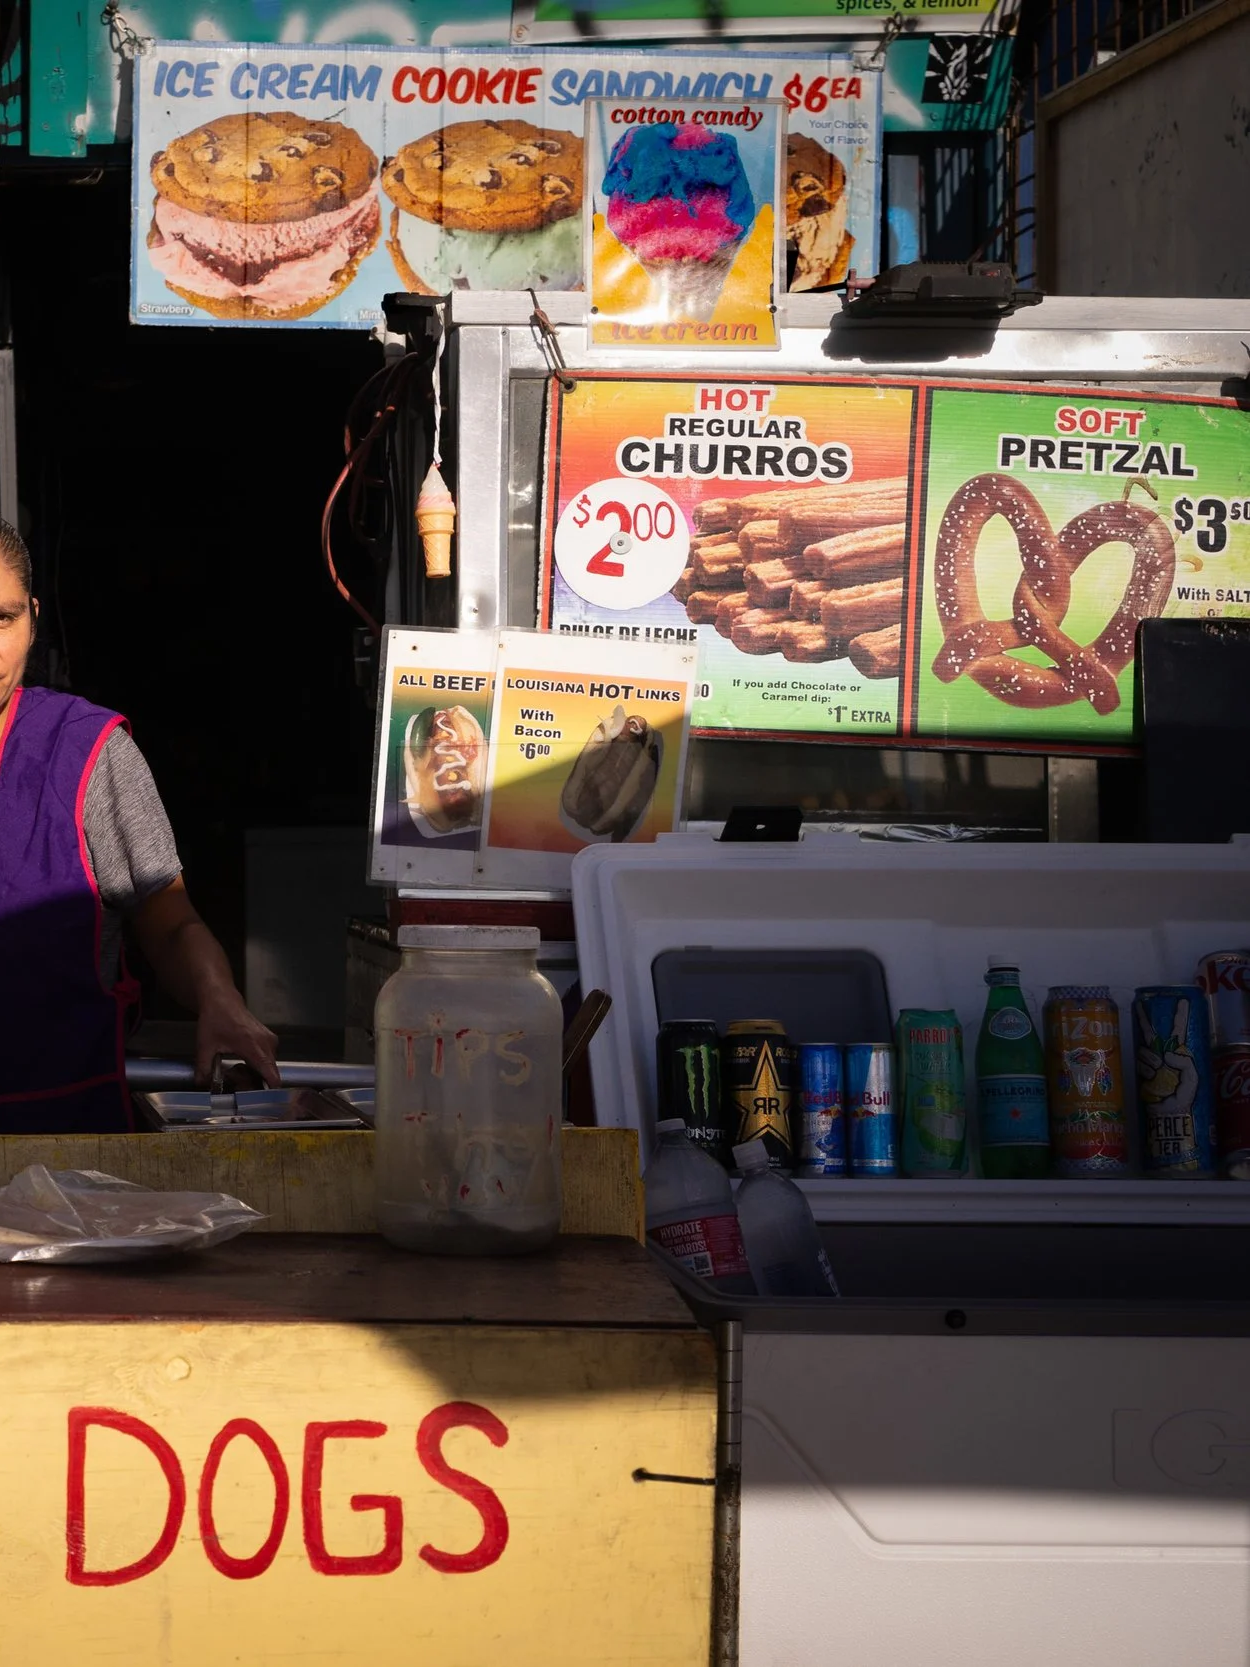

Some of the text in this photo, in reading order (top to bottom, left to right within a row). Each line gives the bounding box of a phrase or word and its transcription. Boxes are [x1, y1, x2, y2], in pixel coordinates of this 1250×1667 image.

[154, 61, 220, 98] ICE
[230, 61, 382, 101] CREAM
[392, 66, 542, 105] COOKIE
[549, 68, 774, 106] SANDWICH
[611, 105, 763, 132] cotton candy
[809, 119, 869, 130] Your Choice
[823, 135, 869, 145] Of Flavor
[141, 303, 195, 315] Strawberry
[359, 309, 382, 320] Mint
[612, 321, 758, 341] ice cream
[700, 388, 771, 411] HOT
[669, 418, 801, 439] REGULAR
[1057, 408, 1144, 436] SOFT
[621, 441, 848, 479] CHURROS
[1000, 437, 1195, 477] PRETZAL
[1177, 587, 1210, 601] With
[398, 674, 427, 686] ALL
[432, 675, 487, 692] BEEF
[507, 679, 585, 694] LOUISIANA
[589, 682, 634, 699] HOT
[636, 689, 681, 702] LINKS
[732, 679, 741, 688] If
[744, 680, 764, 690] you
[767, 681, 788, 690] add
[791, 681, 847, 692] Chocolate
[761, 692, 832, 704] Caramel dip:
[520, 708, 554, 722] With
[851, 710, 892, 723] EXTRA
[514, 725, 562, 739] Bacon
[862, 1090, 891, 1105] Bull
[1148, 1116, 1191, 1137] PEACE
[659, 1220, 704, 1239] HYDRATE
[669, 1240, 708, 1257] EWARDS!
[67, 1401, 510, 1587] DOGS
